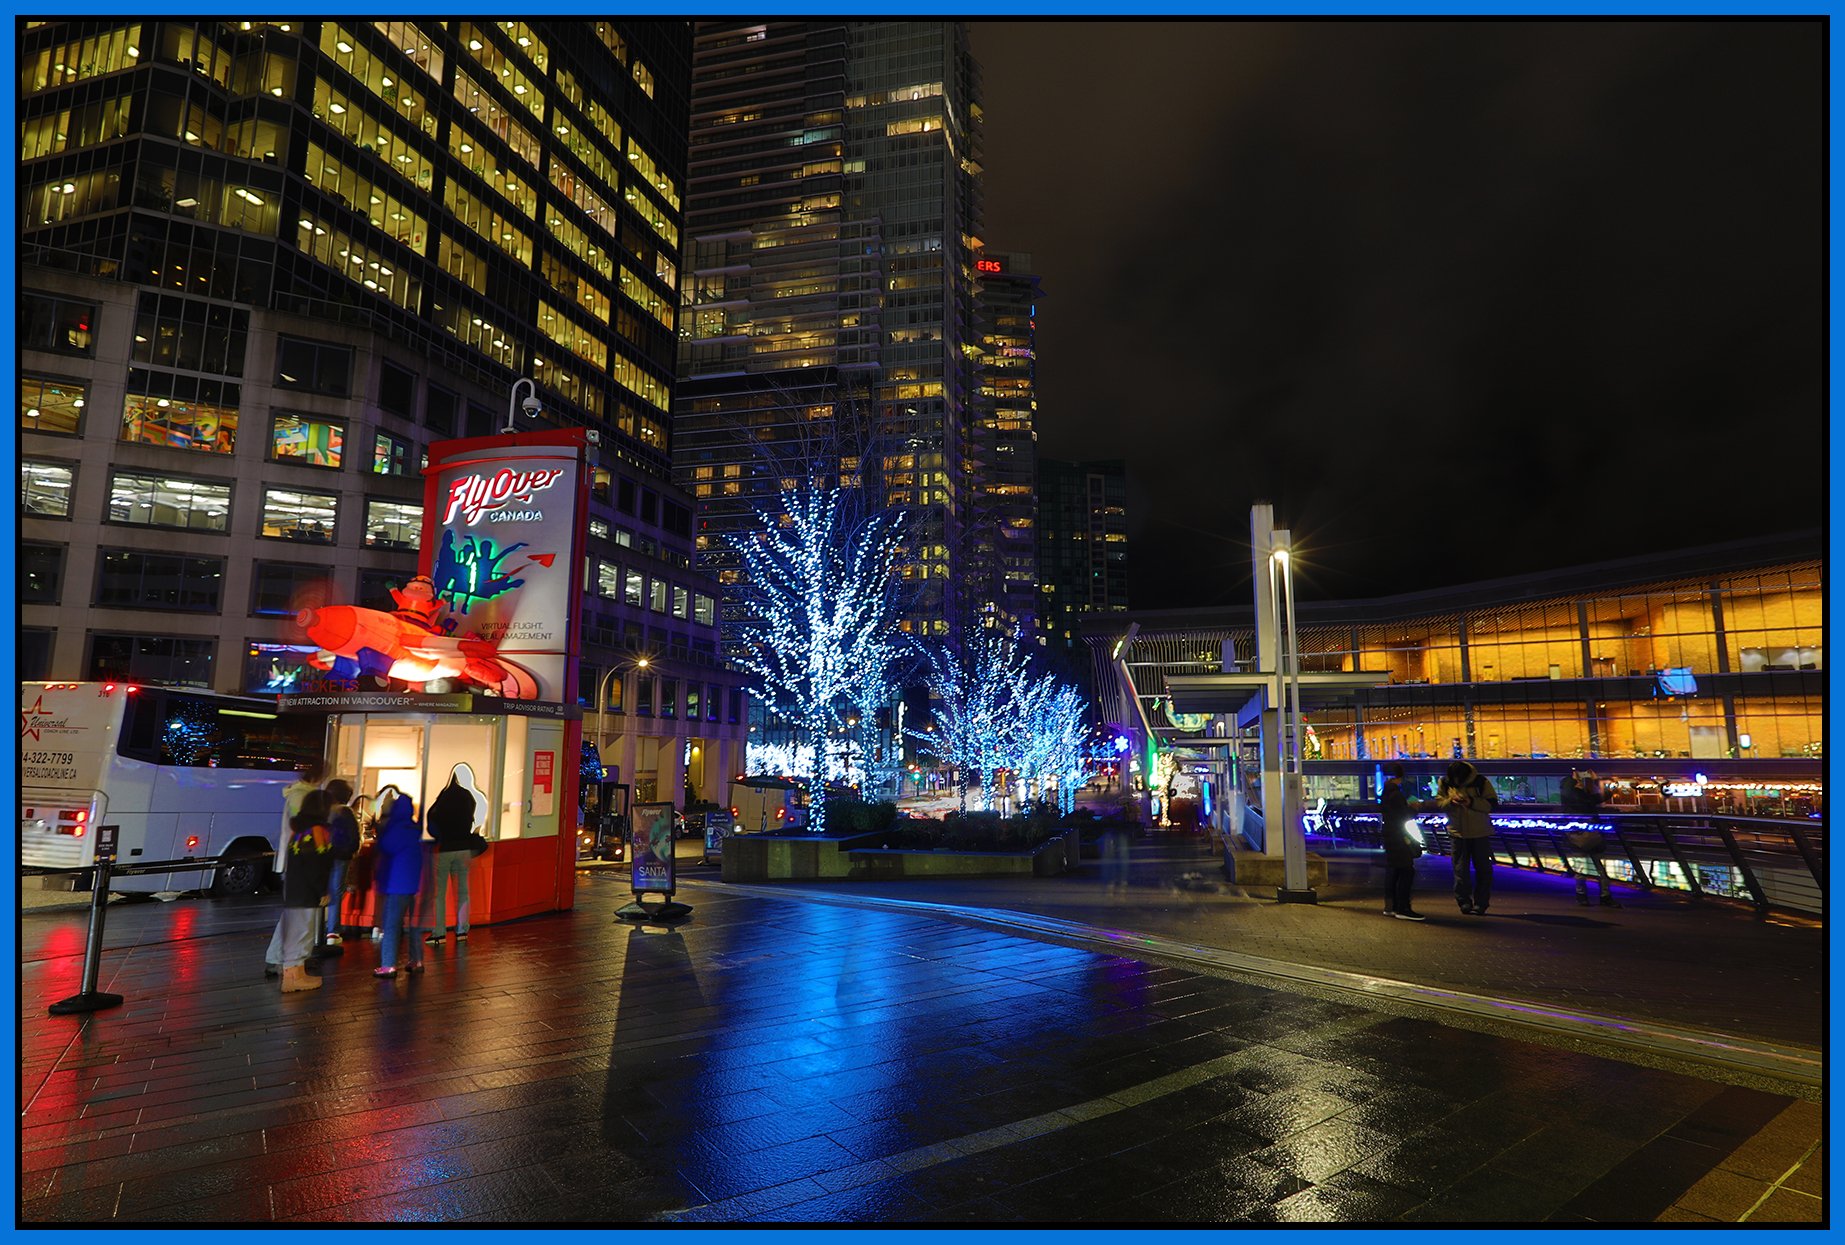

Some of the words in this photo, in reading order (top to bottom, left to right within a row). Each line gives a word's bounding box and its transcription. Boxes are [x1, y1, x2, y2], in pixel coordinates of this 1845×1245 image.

[442, 468, 564, 526] FlyOver
[489, 510, 543, 522] CANADA
[481, 622, 511, 630] VIRTUAL
[500, 632, 553, 640] AMAZEMENT
[297, 696, 339, 706] ATTRACTION
[340, 696, 350, 705] IN
[503, 702, 515, 711] TRIP
[515, 703, 537, 712] ADVISOR
[537, 705, 555, 714] RATING
[30, 715, 68, 728] Universal
[22, 752, 73, 765] 4-322-7799
[638, 866, 667, 877] SANTA
